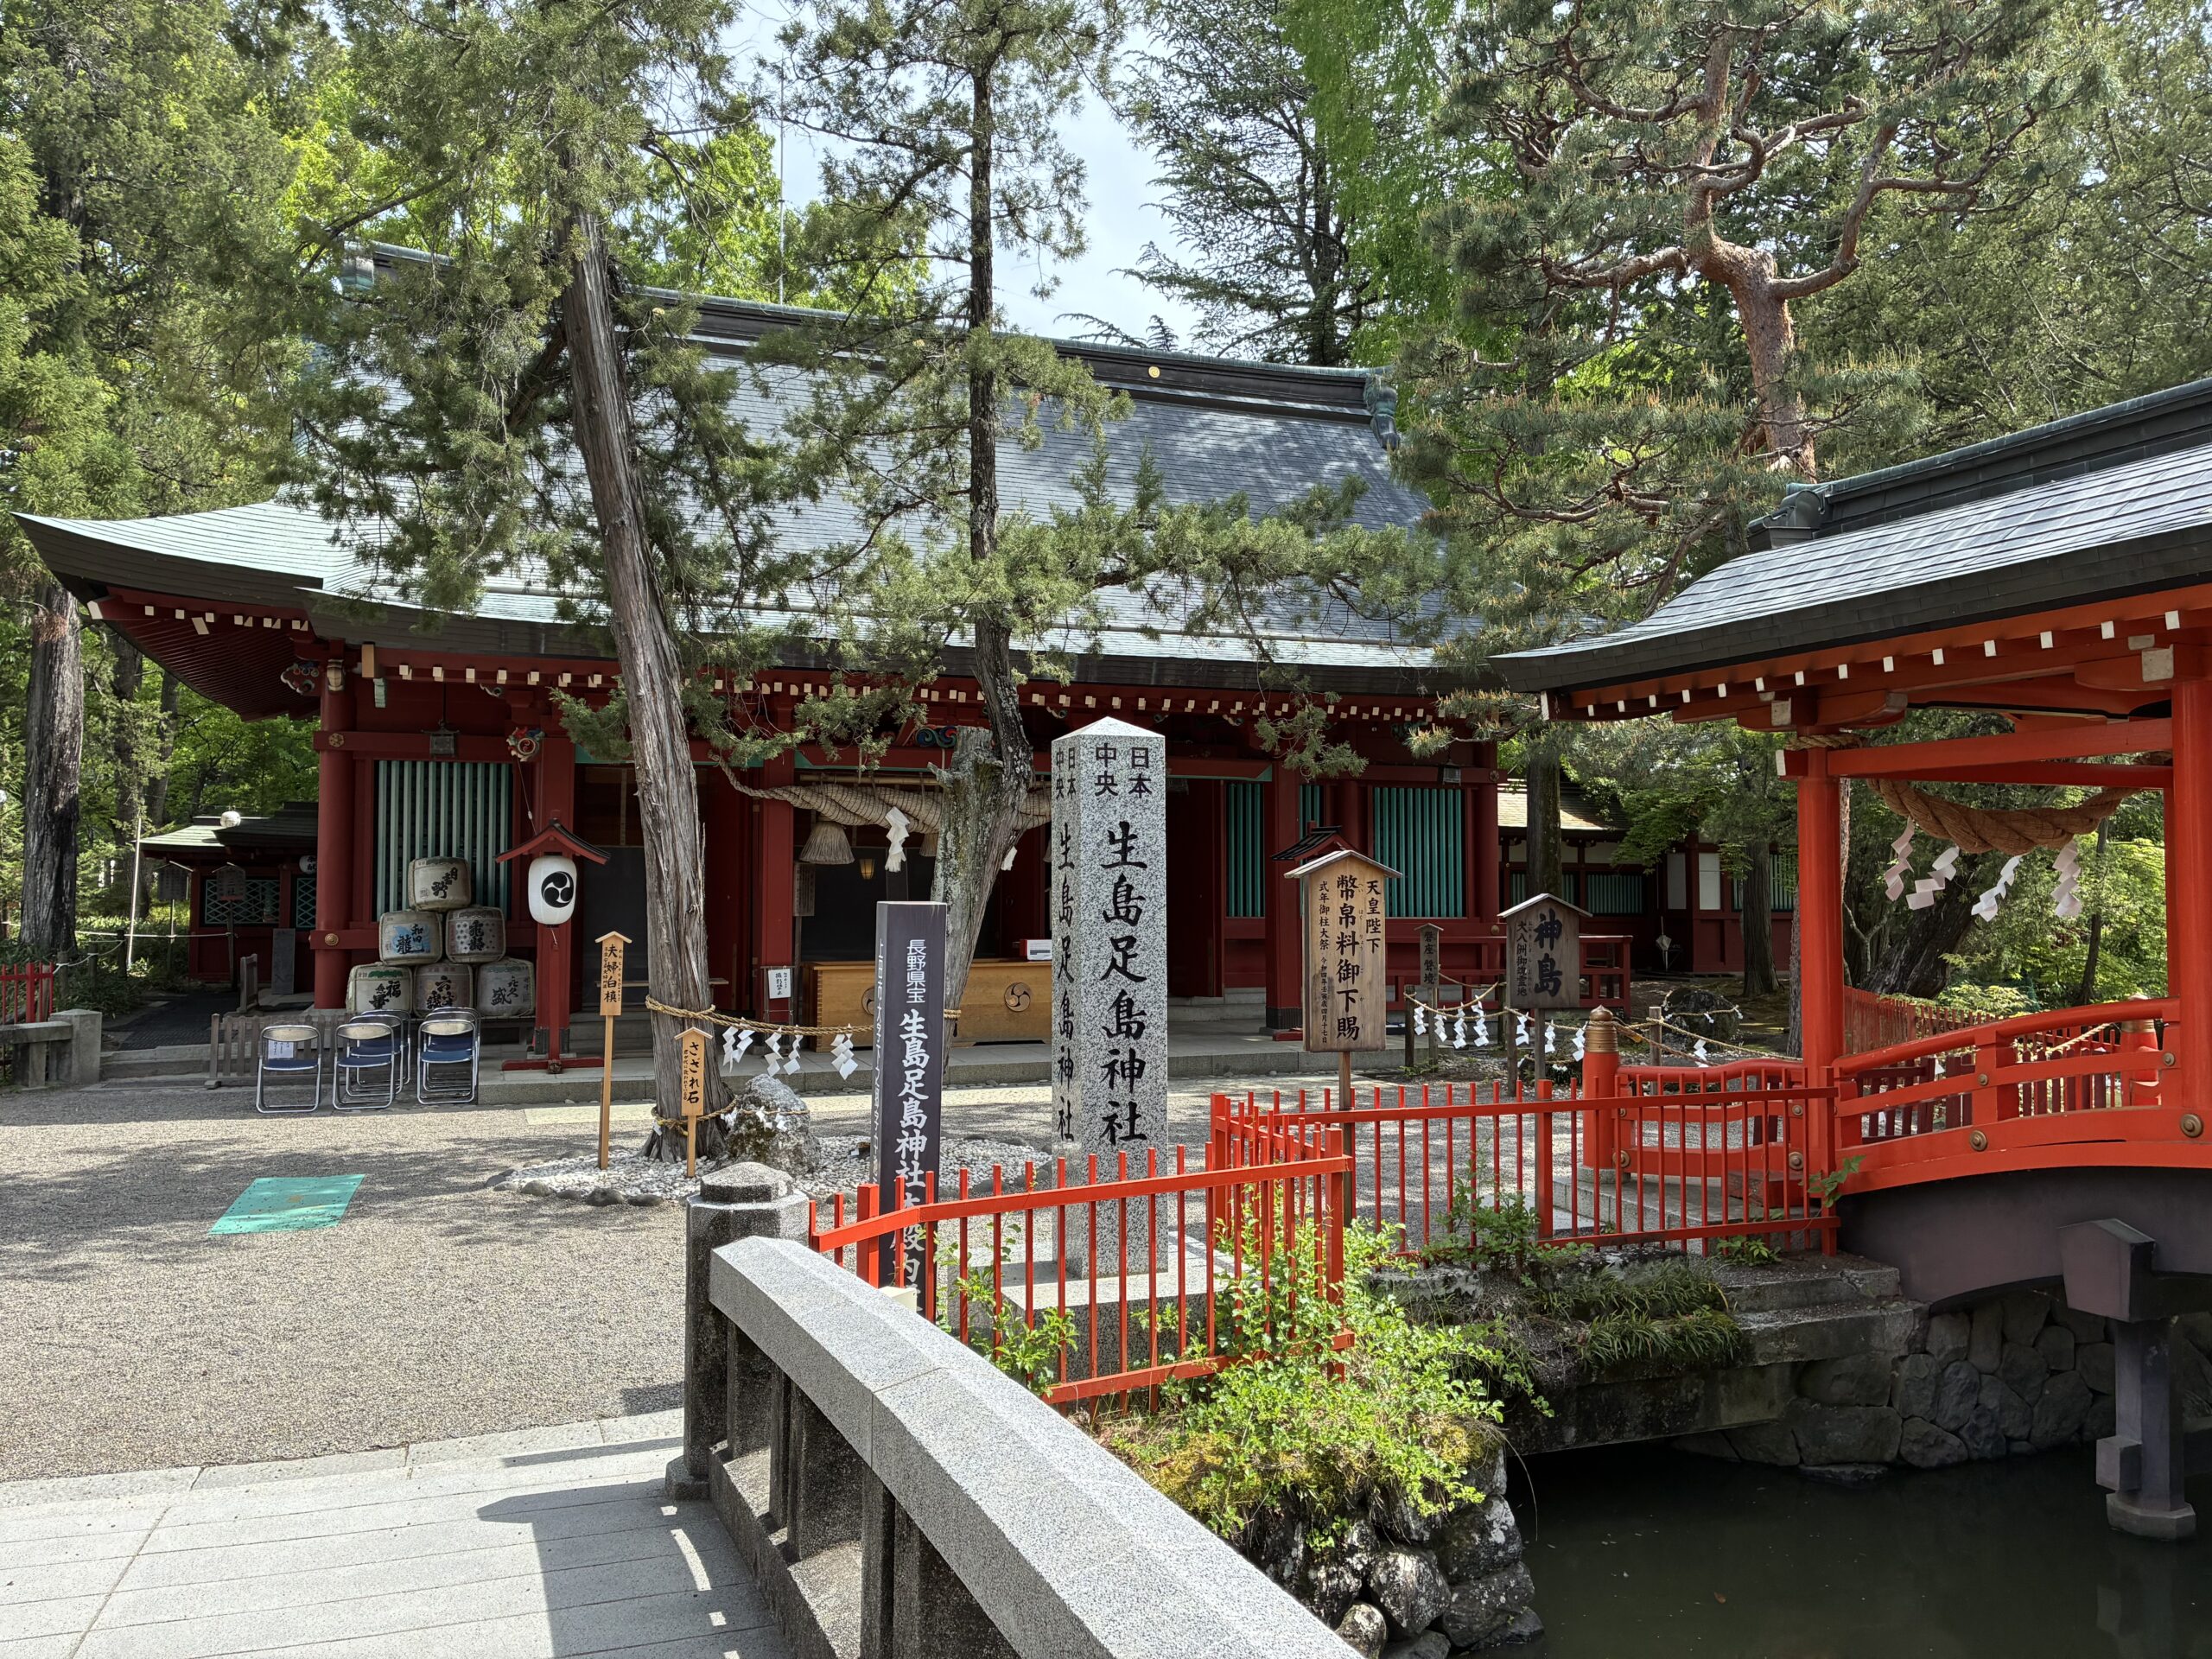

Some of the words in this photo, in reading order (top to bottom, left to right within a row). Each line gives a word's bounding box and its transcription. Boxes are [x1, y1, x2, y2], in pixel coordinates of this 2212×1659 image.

[1319, 880, 1330, 950] 式年御柱大祭
[1366, 880, 1382, 954] 天皇陛下
[1533, 907, 1562, 997] 神島
[906, 938, 927, 1003] 長野県宝
[1057, 822, 1075, 1143] 生島足島神社
[1100, 821, 1147, 1145] 生島足島神社
[1336, 874, 1359, 1041] 幣帛料御下賜
[687, 1041, 700, 1104] さざれ石
